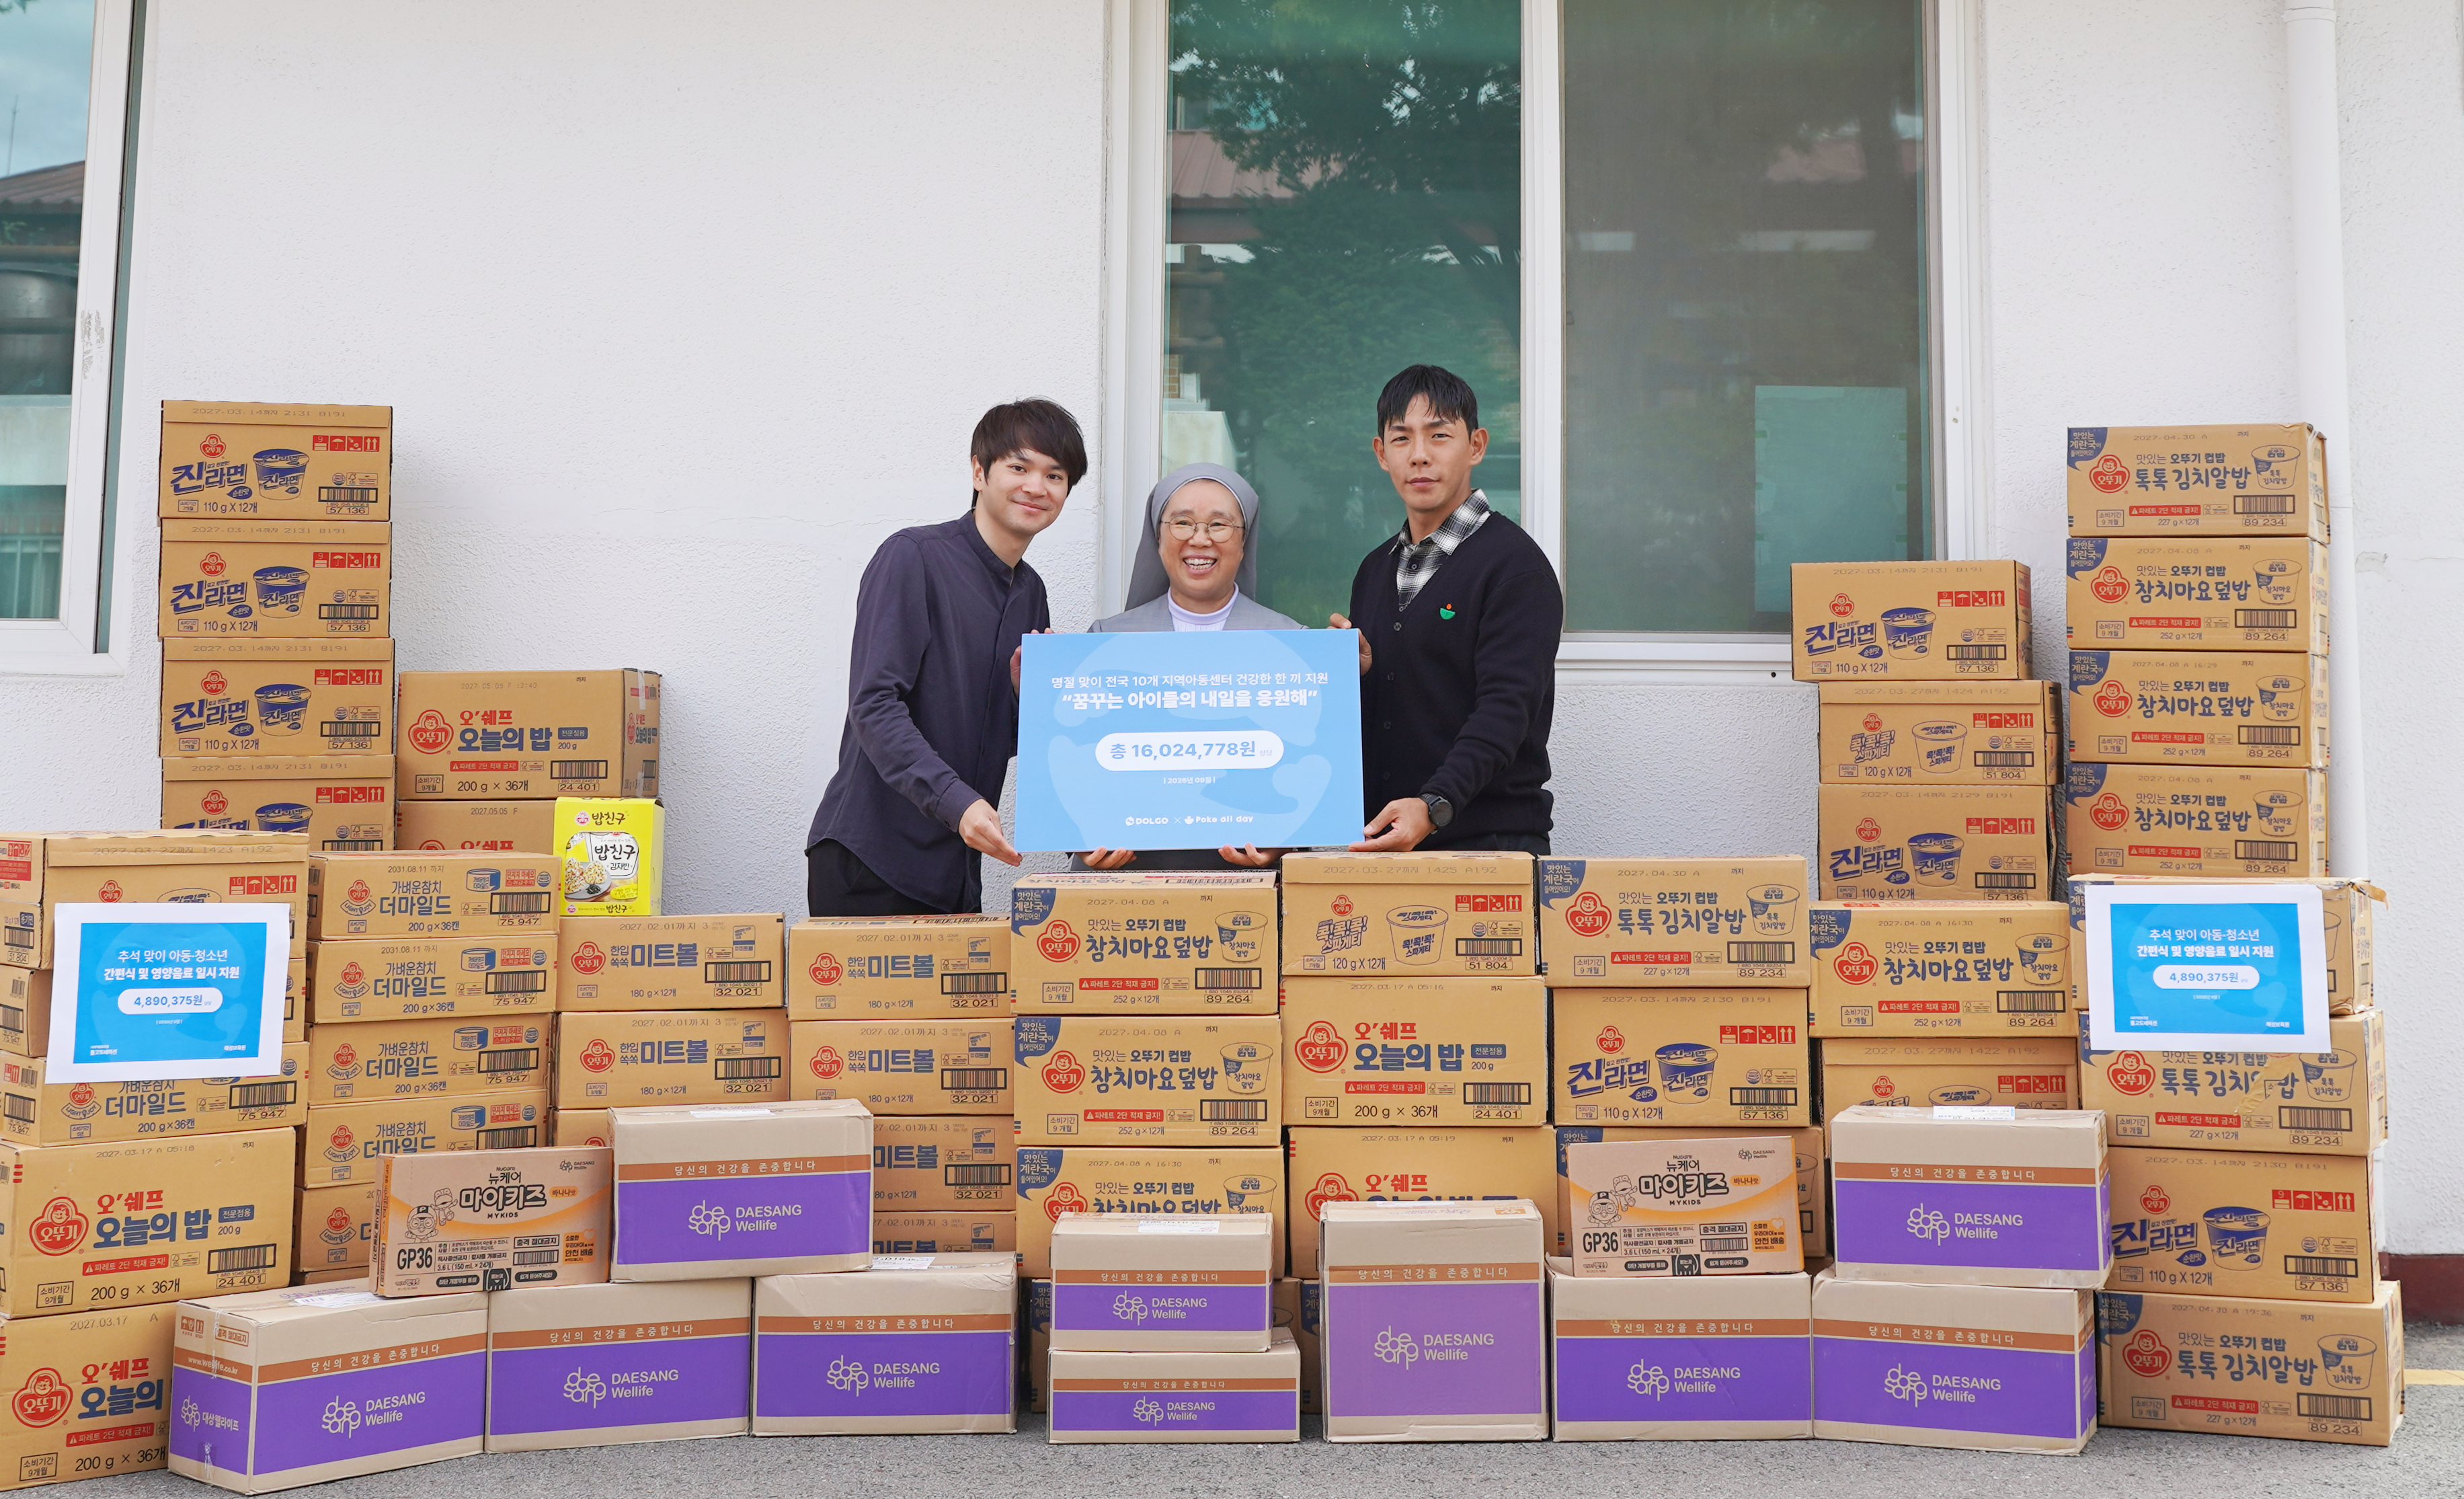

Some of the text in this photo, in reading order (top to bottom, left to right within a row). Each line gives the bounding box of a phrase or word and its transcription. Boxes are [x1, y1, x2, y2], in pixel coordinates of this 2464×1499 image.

[170, 461, 247, 496] 진라면
[2135, 467, 2250, 491] 톡톡 김치알밥
[204, 503, 218, 512] 110
[239, 502, 257, 514] 12개
[1804, 621, 1876, 656] 진라면
[1051, 672, 1328, 689] 명절 맞이 전국 10개 지역아동센터 건강한 한 끼 지원
[1127, 691, 1195, 708] 아이들의
[1201, 690, 1252, 707] 내일을
[416, 731, 446, 744] 오뚜기
[457, 728, 524, 751] 오늘의
[530, 728, 552, 751] 밥
[1110, 744, 1126, 759] 총
[1131, 741, 1255, 761] 16,024,778원
[457, 781, 478, 792] 200
[506, 781, 528, 792] 36개
[592, 812, 626, 825] 밥친구
[594, 845, 635, 860] 밥친구
[610, 862, 629, 870] 김자반
[391, 880, 442, 894] 가벼운참치
[1017, 892, 1041, 902] 맛있는
[1618, 892, 1717, 905] 맛있는 오뚜기 컵밥
[379, 896, 452, 916] 더마일드
[519, 917, 539, 925] 947
[1088, 919, 1186, 931] 맛있는 오뚜기 컵밥
[1618, 908, 1747, 935] 톡톡 김치알밥
[2149, 929, 2260, 941] 추석 맞이 아동·청소년
[1045, 942, 1072, 954] 오뚜기
[1321, 931, 1361, 954] 스파게티
[118, 950, 228, 962] 추석 맞이 아동·청소년
[610, 943, 699, 967] 한입 미트볼
[2137, 946, 2274, 958] 간편식 및 영양음료 일시 지원
[578, 958, 600, 968] 오뚜기
[610, 958, 629, 968] 쏙쏙
[1333, 959, 1348, 970] 120
[1368, 958, 1386, 970] 12개
[104, 967, 239, 981] 간편식 및 영양음료 일시 지원
[1739, 968, 1784, 977] 89 234
[2170, 971, 2239, 983] 4,890,375원
[1045, 985, 1070, 993] 소비기간
[1090, 979, 1156, 988] 파레트 2단 적재 금지!
[134, 995, 202, 1008] 4,890,375원
[1206, 995, 1251, 1003] 89 264
[1353, 1043, 1431, 1071] 오늘의
[1437, 1044, 1464, 1071] 밥
[1743, 1111, 1784, 1120] 57 136
[675, 1161, 816, 1176] 당신의 건강을 존중합니다
[489, 1172, 521, 1184] 뉴케어
[1639, 1173, 1728, 1198] 마이키즈
[460, 1185, 547, 1211] 마이키즈
[736, 1204, 802, 1218] DAESANG
[736, 1219, 777, 1231] Wellife
[1954, 1213, 2023, 1226] DAESANG
[1955, 1227, 1998, 1239] Wellife
[397, 1247, 432, 1270] GP36
[71, 1313, 158, 1330] 2027.03.17 A
[1424, 1334, 1494, 1346] DAESANG
[1424, 1348, 1468, 1360] Wellife
[2178, 1350, 2318, 1386] 톡톡 김치알밥
[24, 1396, 61, 1414] 오뚜기
[78, 1379, 163, 1419] 오늘의
[366, 1392, 426, 1411] DAESANG
[366, 1411, 403, 1426] Wellife
[2311, 1424, 2360, 1434] 89 234
